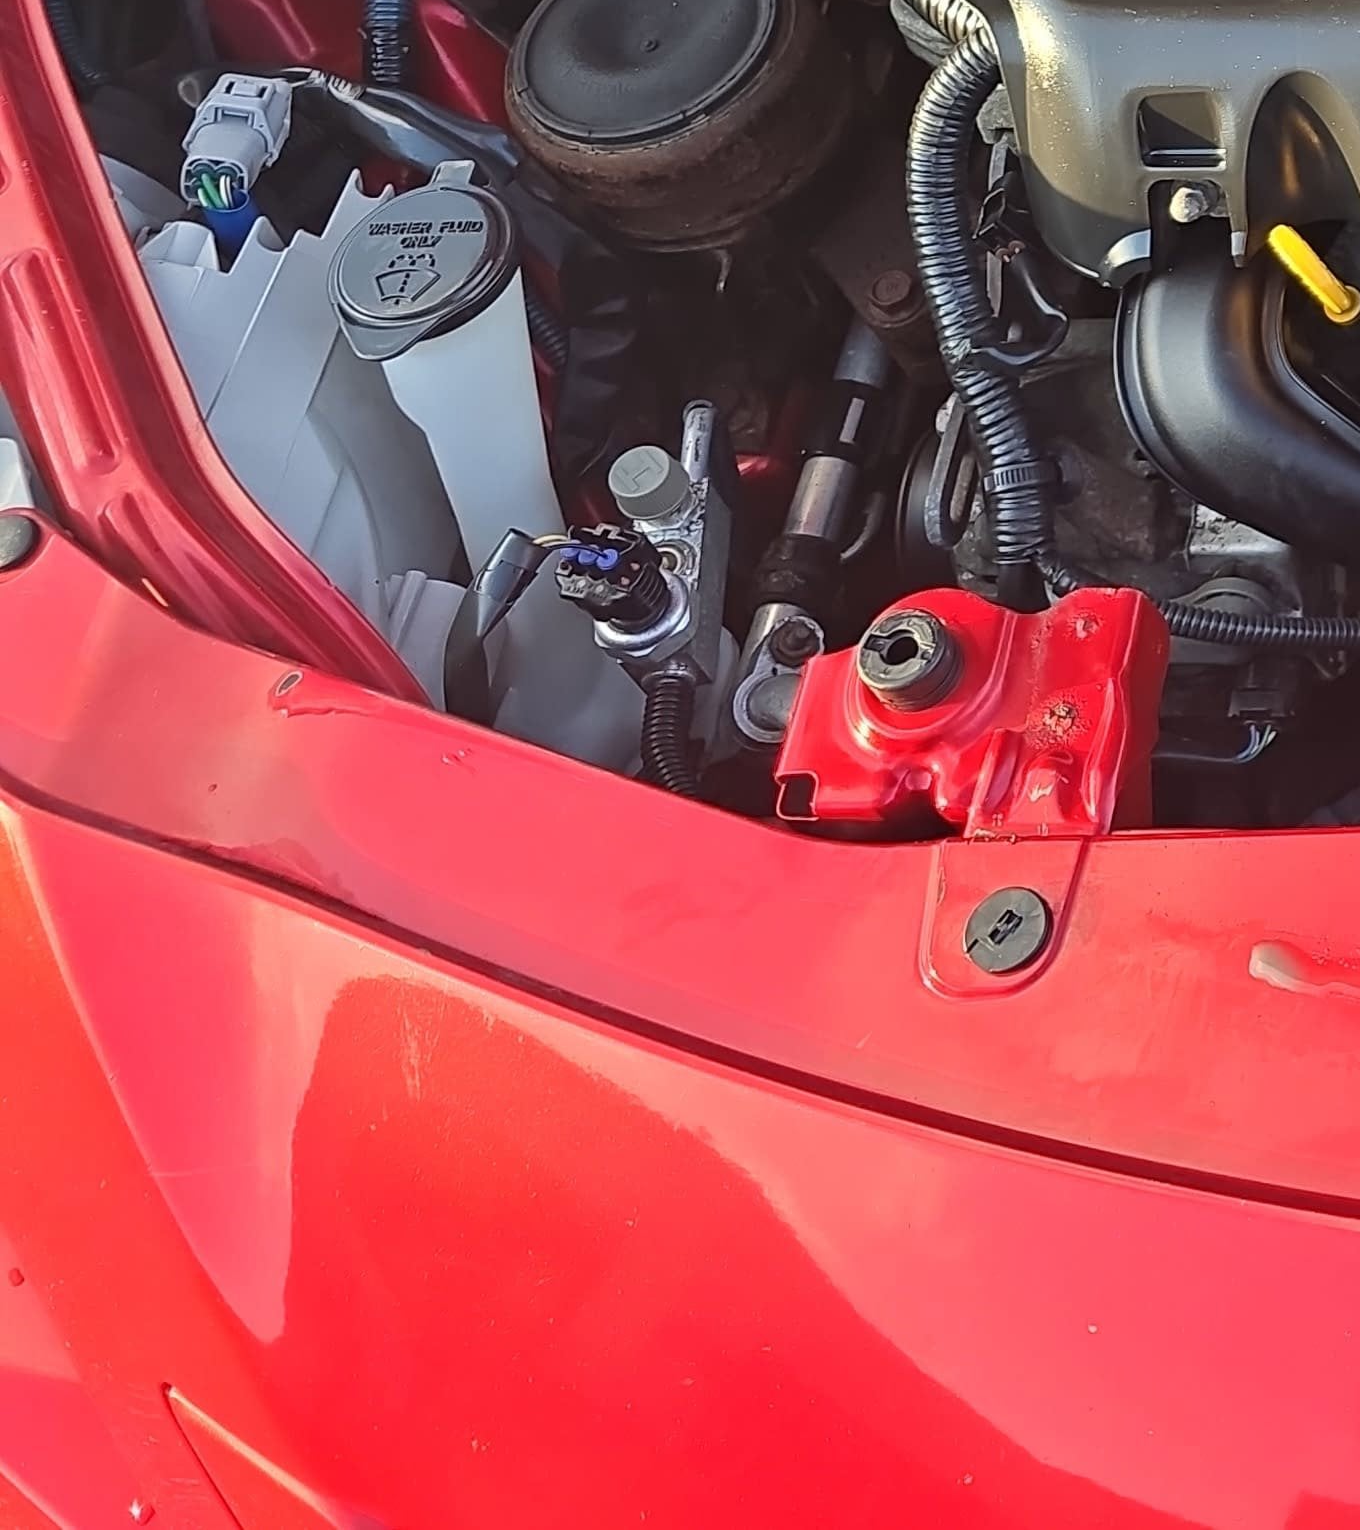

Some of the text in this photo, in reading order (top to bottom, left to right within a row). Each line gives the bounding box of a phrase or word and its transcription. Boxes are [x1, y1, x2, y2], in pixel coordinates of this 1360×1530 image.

[369, 221, 484, 236] WASHER FLUID
[400, 236, 443, 248] ONLY
